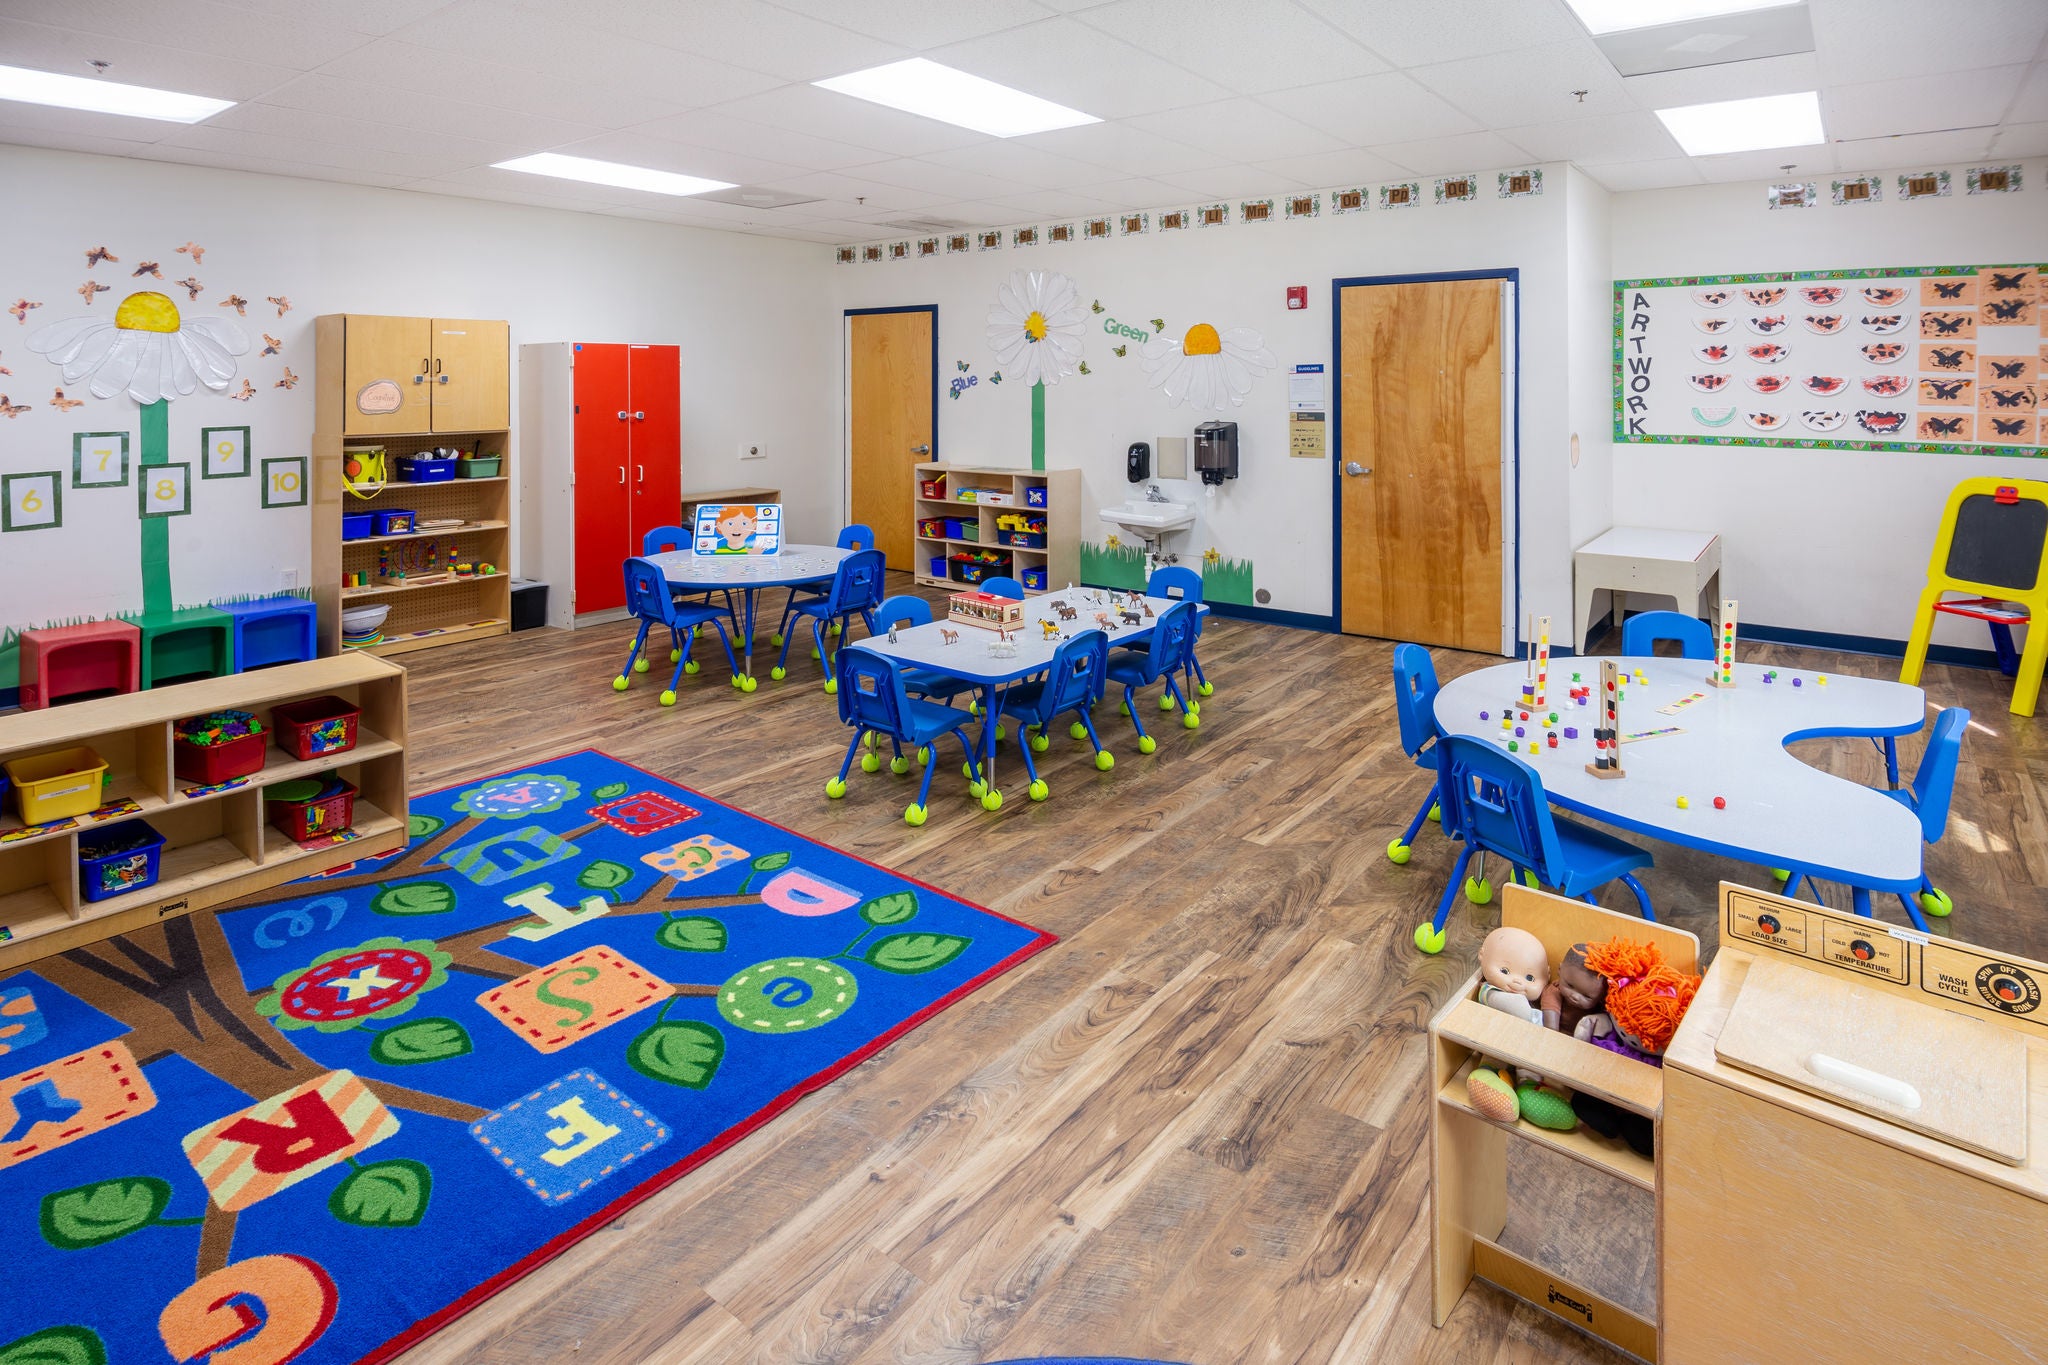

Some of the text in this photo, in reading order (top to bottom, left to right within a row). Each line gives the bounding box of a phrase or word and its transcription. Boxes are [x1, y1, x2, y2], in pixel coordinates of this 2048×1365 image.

[1846, 183, 1865, 198] Tt
[1913, 178, 1936, 193] Uu
[1166, 215, 1180, 227] Kk
[1247, 205, 1267, 218] Mm
[1295, 200, 1310, 213] Nn
[1343, 194, 1359, 206] Oo
[1392, 188, 1408, 202] Pp
[1447, 183, 1466, 197] Qq
[1512, 177, 1529, 191] Rr
[1103, 317, 1149, 344] Green
[951, 373, 978, 393] Blue
[93, 449, 112, 472] 7
[217, 441, 235, 463] 9
[154, 479, 177, 501] 8
[272, 472, 300, 493] 10
[21, 489, 43, 513] 6
[1737, 913, 1755, 922] SMALL
[1758, 905, 1780, 915] MEDIUM
[1751, 930, 1788, 946] LOAD SIZE
[1785, 926, 1803, 935] LARGE
[1853, 930, 1872, 939] WARM
[1831, 938, 1847, 947] COLD
[1835, 953, 1891, 975] TEMPERATURE
[1878, 951, 1890, 959] HOT
[1978, 967, 1994, 981] SPIN
[2000, 965, 2017, 975] OFF
[1938, 981, 1969, 996] CYCLE
[1939, 973, 1968, 988] WASH
[2023, 978, 2039, 1001] WASH
[1979, 986, 2003, 1007] RINSE
[2011, 1001, 2035, 1013] SOAK
